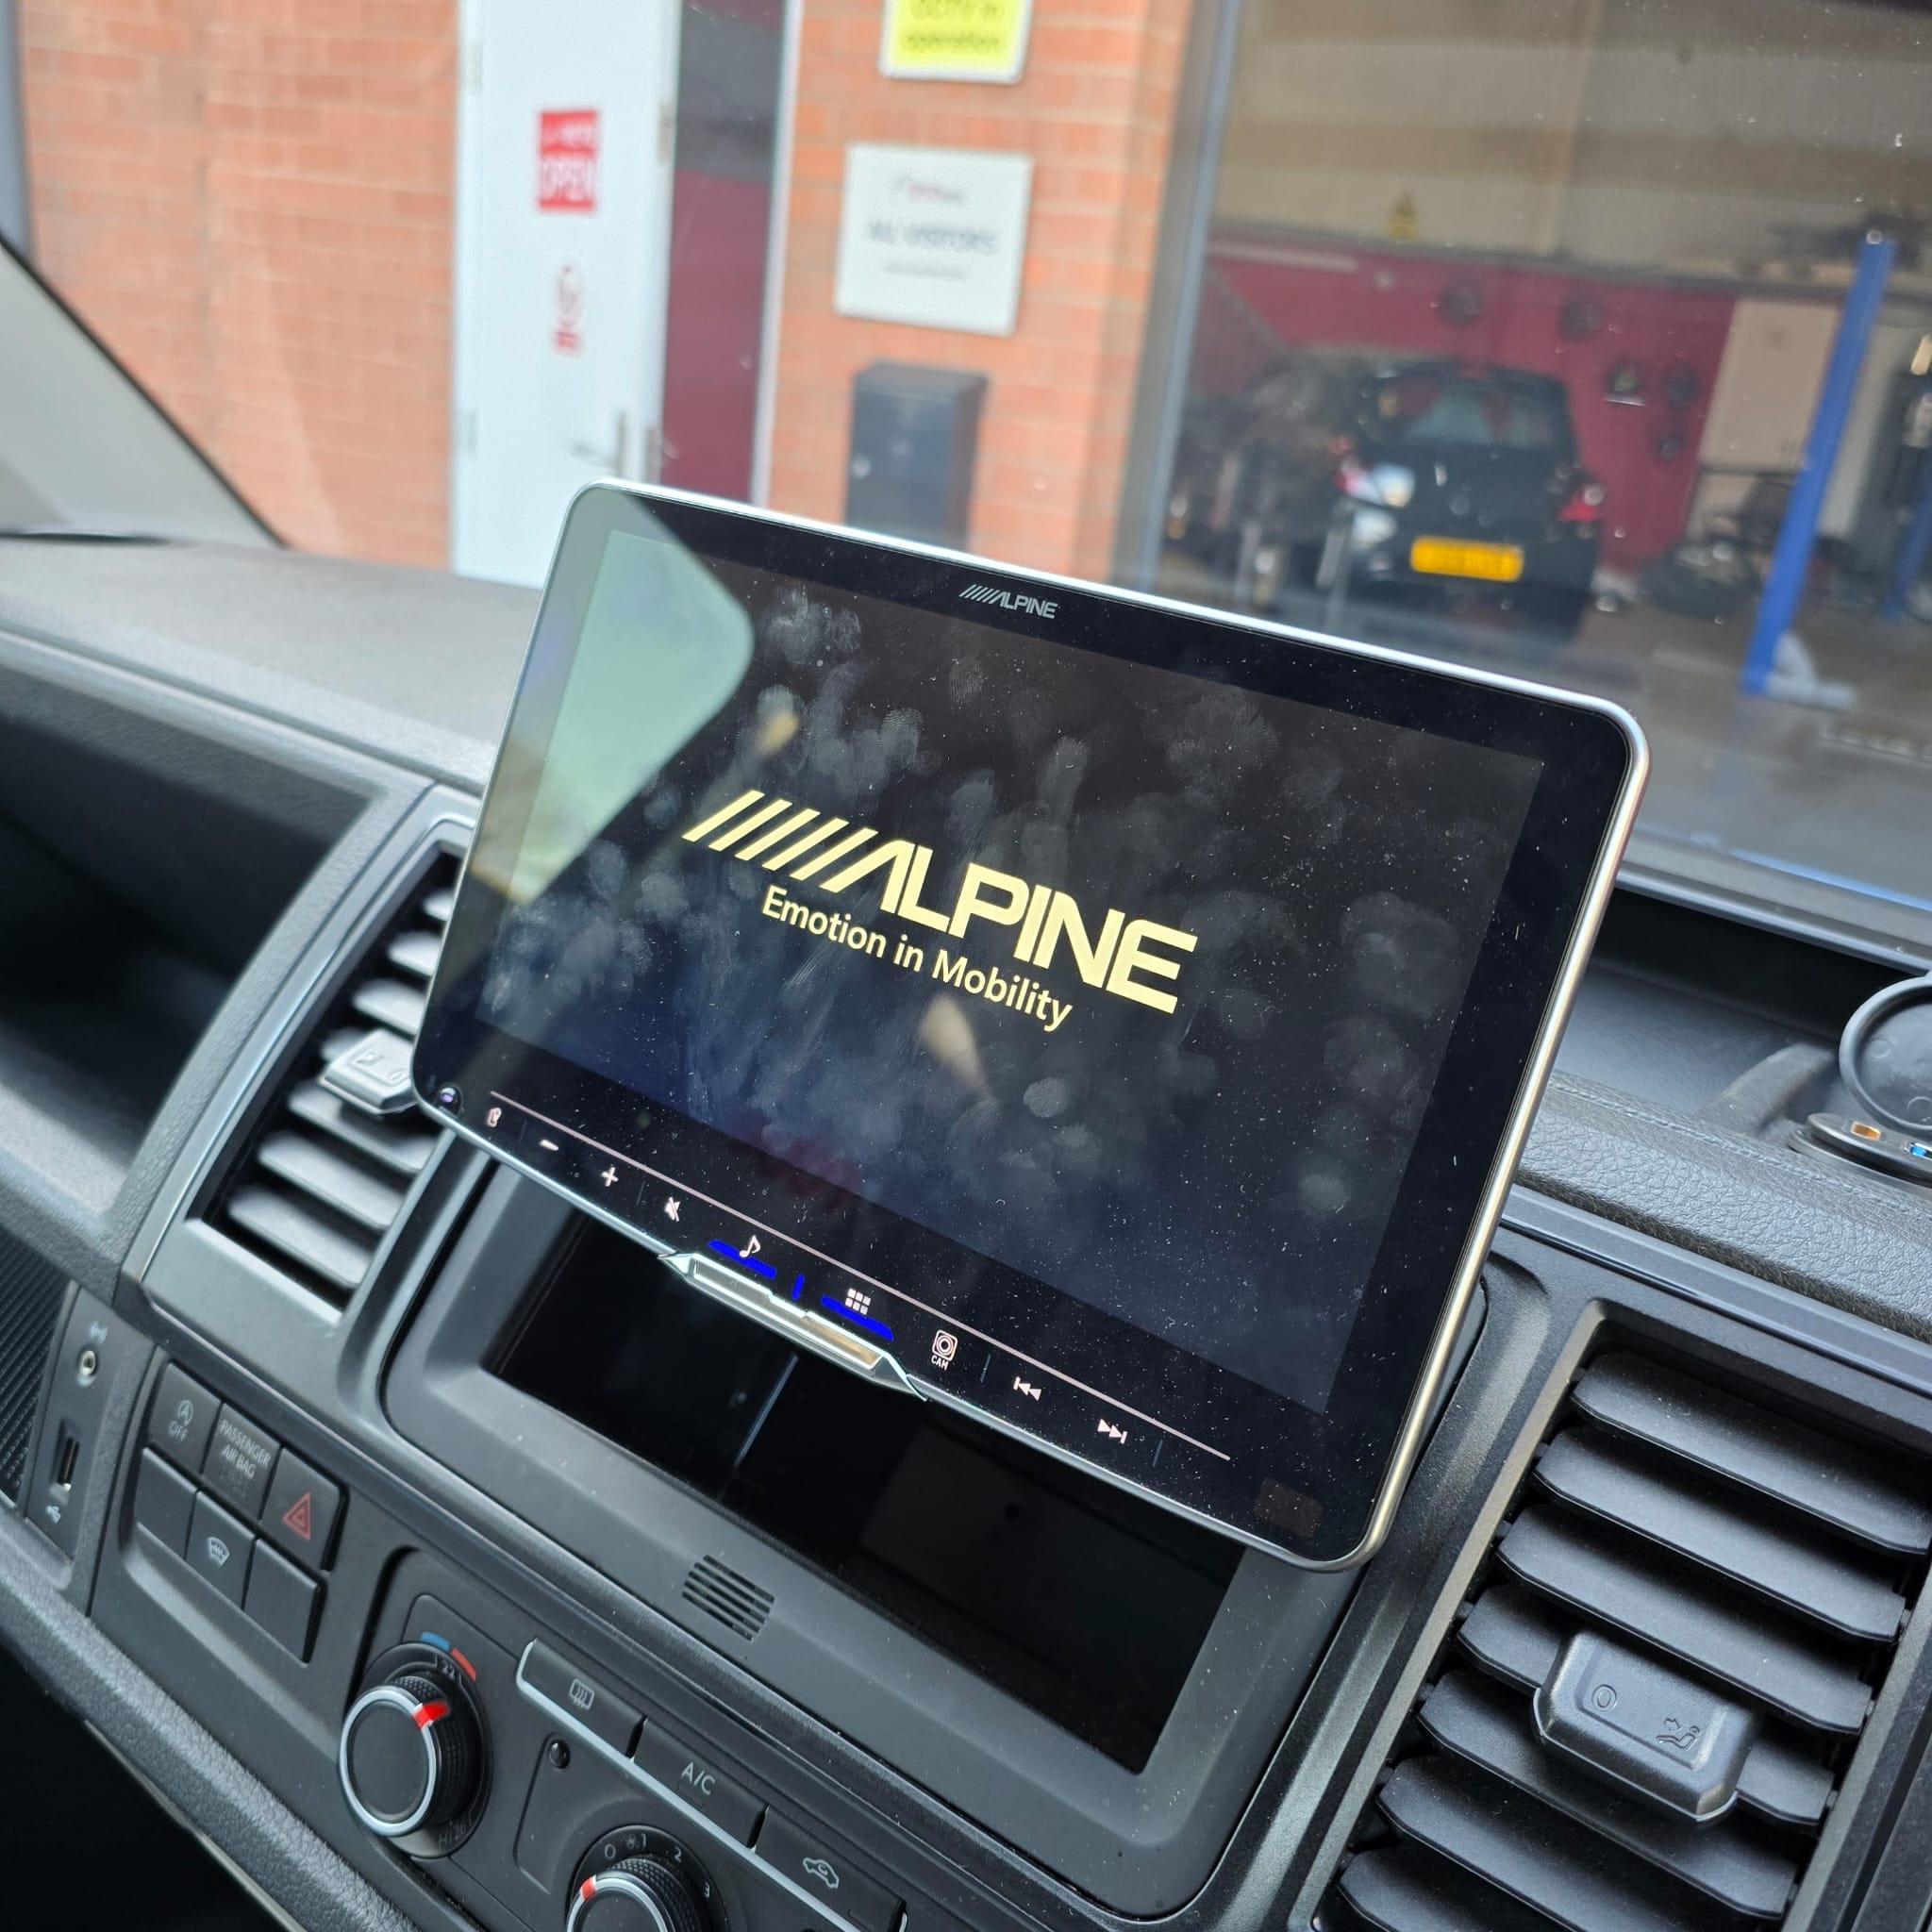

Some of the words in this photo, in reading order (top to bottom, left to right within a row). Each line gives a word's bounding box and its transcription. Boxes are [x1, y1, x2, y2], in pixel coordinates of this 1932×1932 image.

[988, 591, 1058, 620] ALPINE
[819, 840, 1198, 1014] ALPINE
[761, 884, 888, 958] Emotion
[892, 933, 924, 973] in
[931, 948, 1074, 1033] Mobility
[930, 1355, 949, 1371] CAM
[170, 1420, 189, 1441] OFF
[220, 1420, 271, 1467] PASSENGER
[222, 1444, 257, 1480] AIRBAG
[679, 1761, 716, 1795] A/C
[641, 1833, 647, 1847] 1
[674, 1846, 683, 1863] 2
